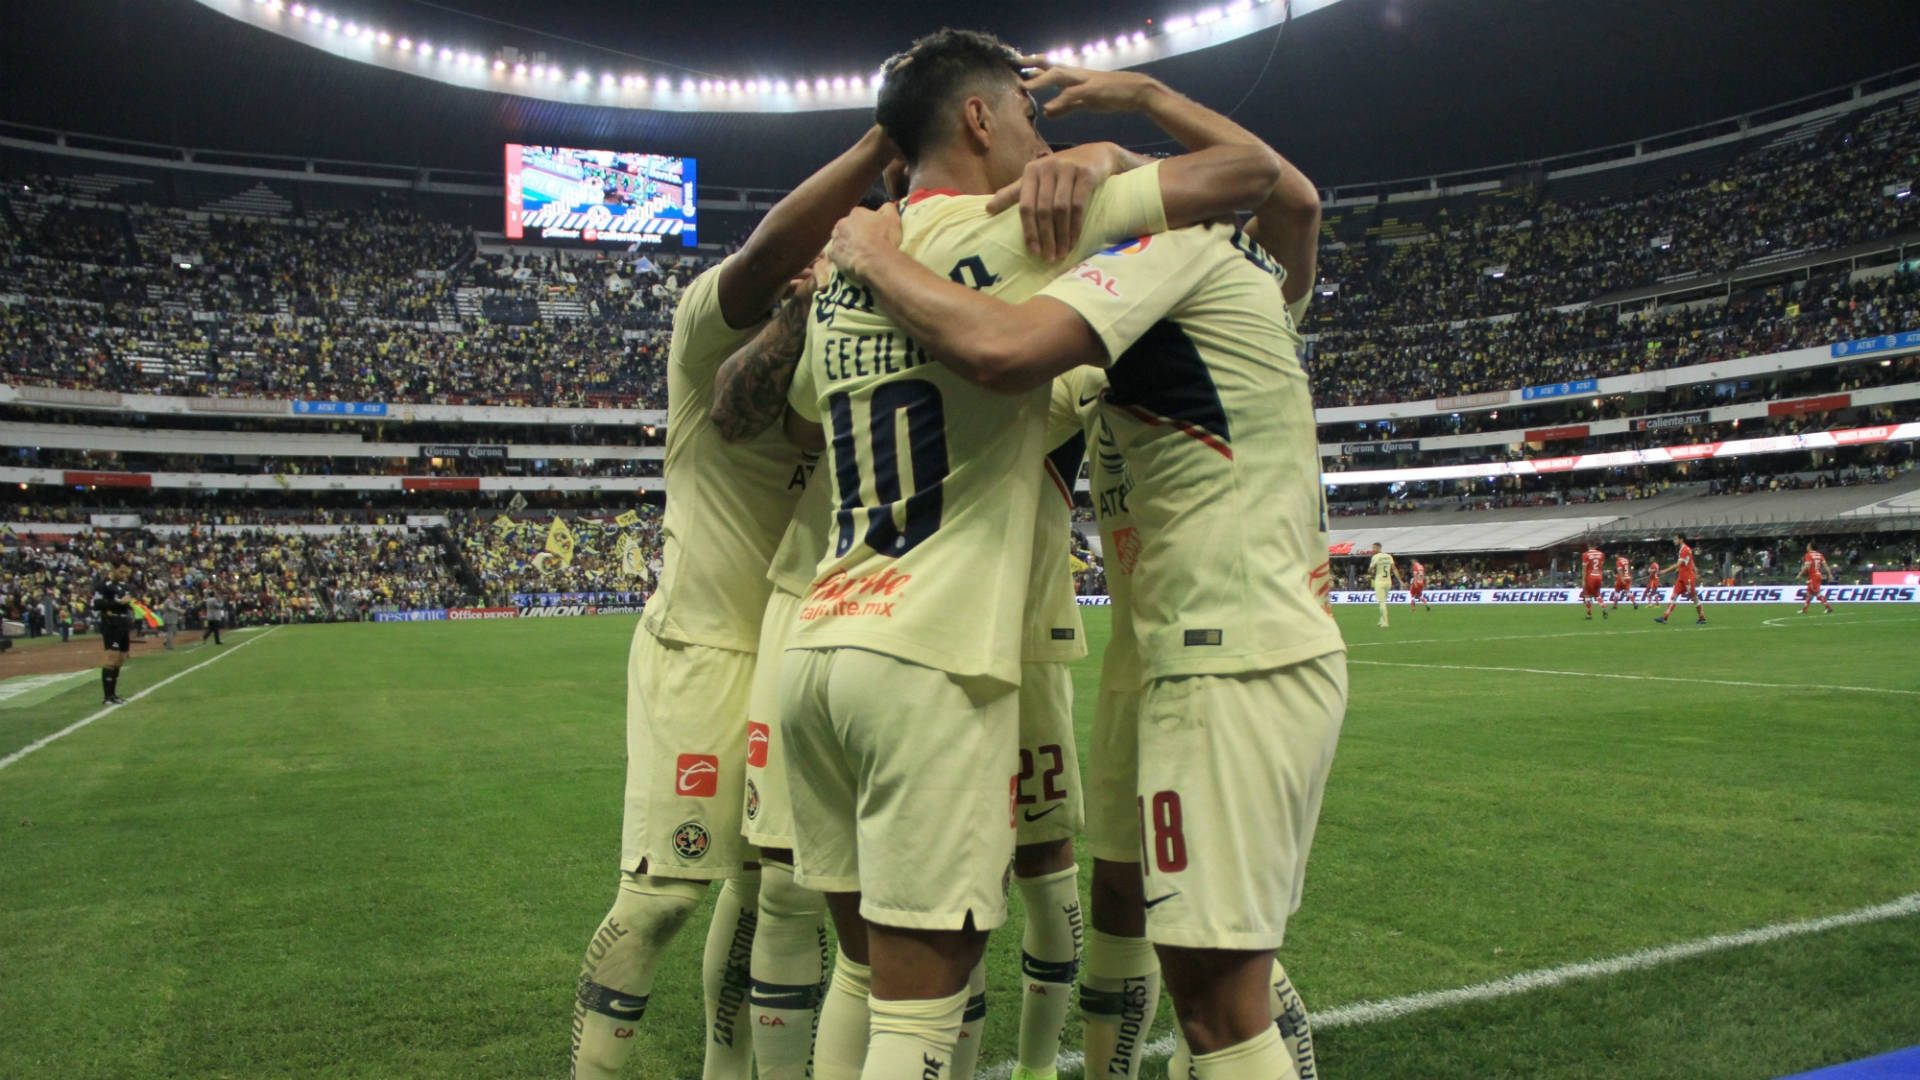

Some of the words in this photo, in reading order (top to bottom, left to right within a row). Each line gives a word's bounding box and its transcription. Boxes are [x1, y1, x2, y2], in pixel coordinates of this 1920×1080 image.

[1905, 333, 1920, 343] AT&
[1856, 339, 1877, 350] AT&T
[824, 332, 933, 381] CECILI
[1540, 386, 1555, 395] AT&T
[1576, 381, 1592, 390] AT&T
[317, 403, 336, 412] AT&T
[363, 404, 382, 413] AT&T
[1646, 414, 1702, 429] caliente.mx
[424, 446, 460, 457] Corona
[468, 446, 503, 458] Corona
[1344, 444, 1375, 455] Corona
[1381, 441, 1413, 453] Corona
[829, 379, 950, 558] 10
[1347, 592, 1406, 603] SKECERS
[1416, 591, 1481, 603] KECHERS
[1492, 590, 1570, 602] SKECHERS
[449, 610, 484, 620] Office
[484, 611, 515, 619] DEPOT
[519, 605, 585, 617] UNION
[597, 605, 645, 615] caliente.m
[1017, 744, 1067, 804] 22
[759, 1015, 785, 1027] CA
